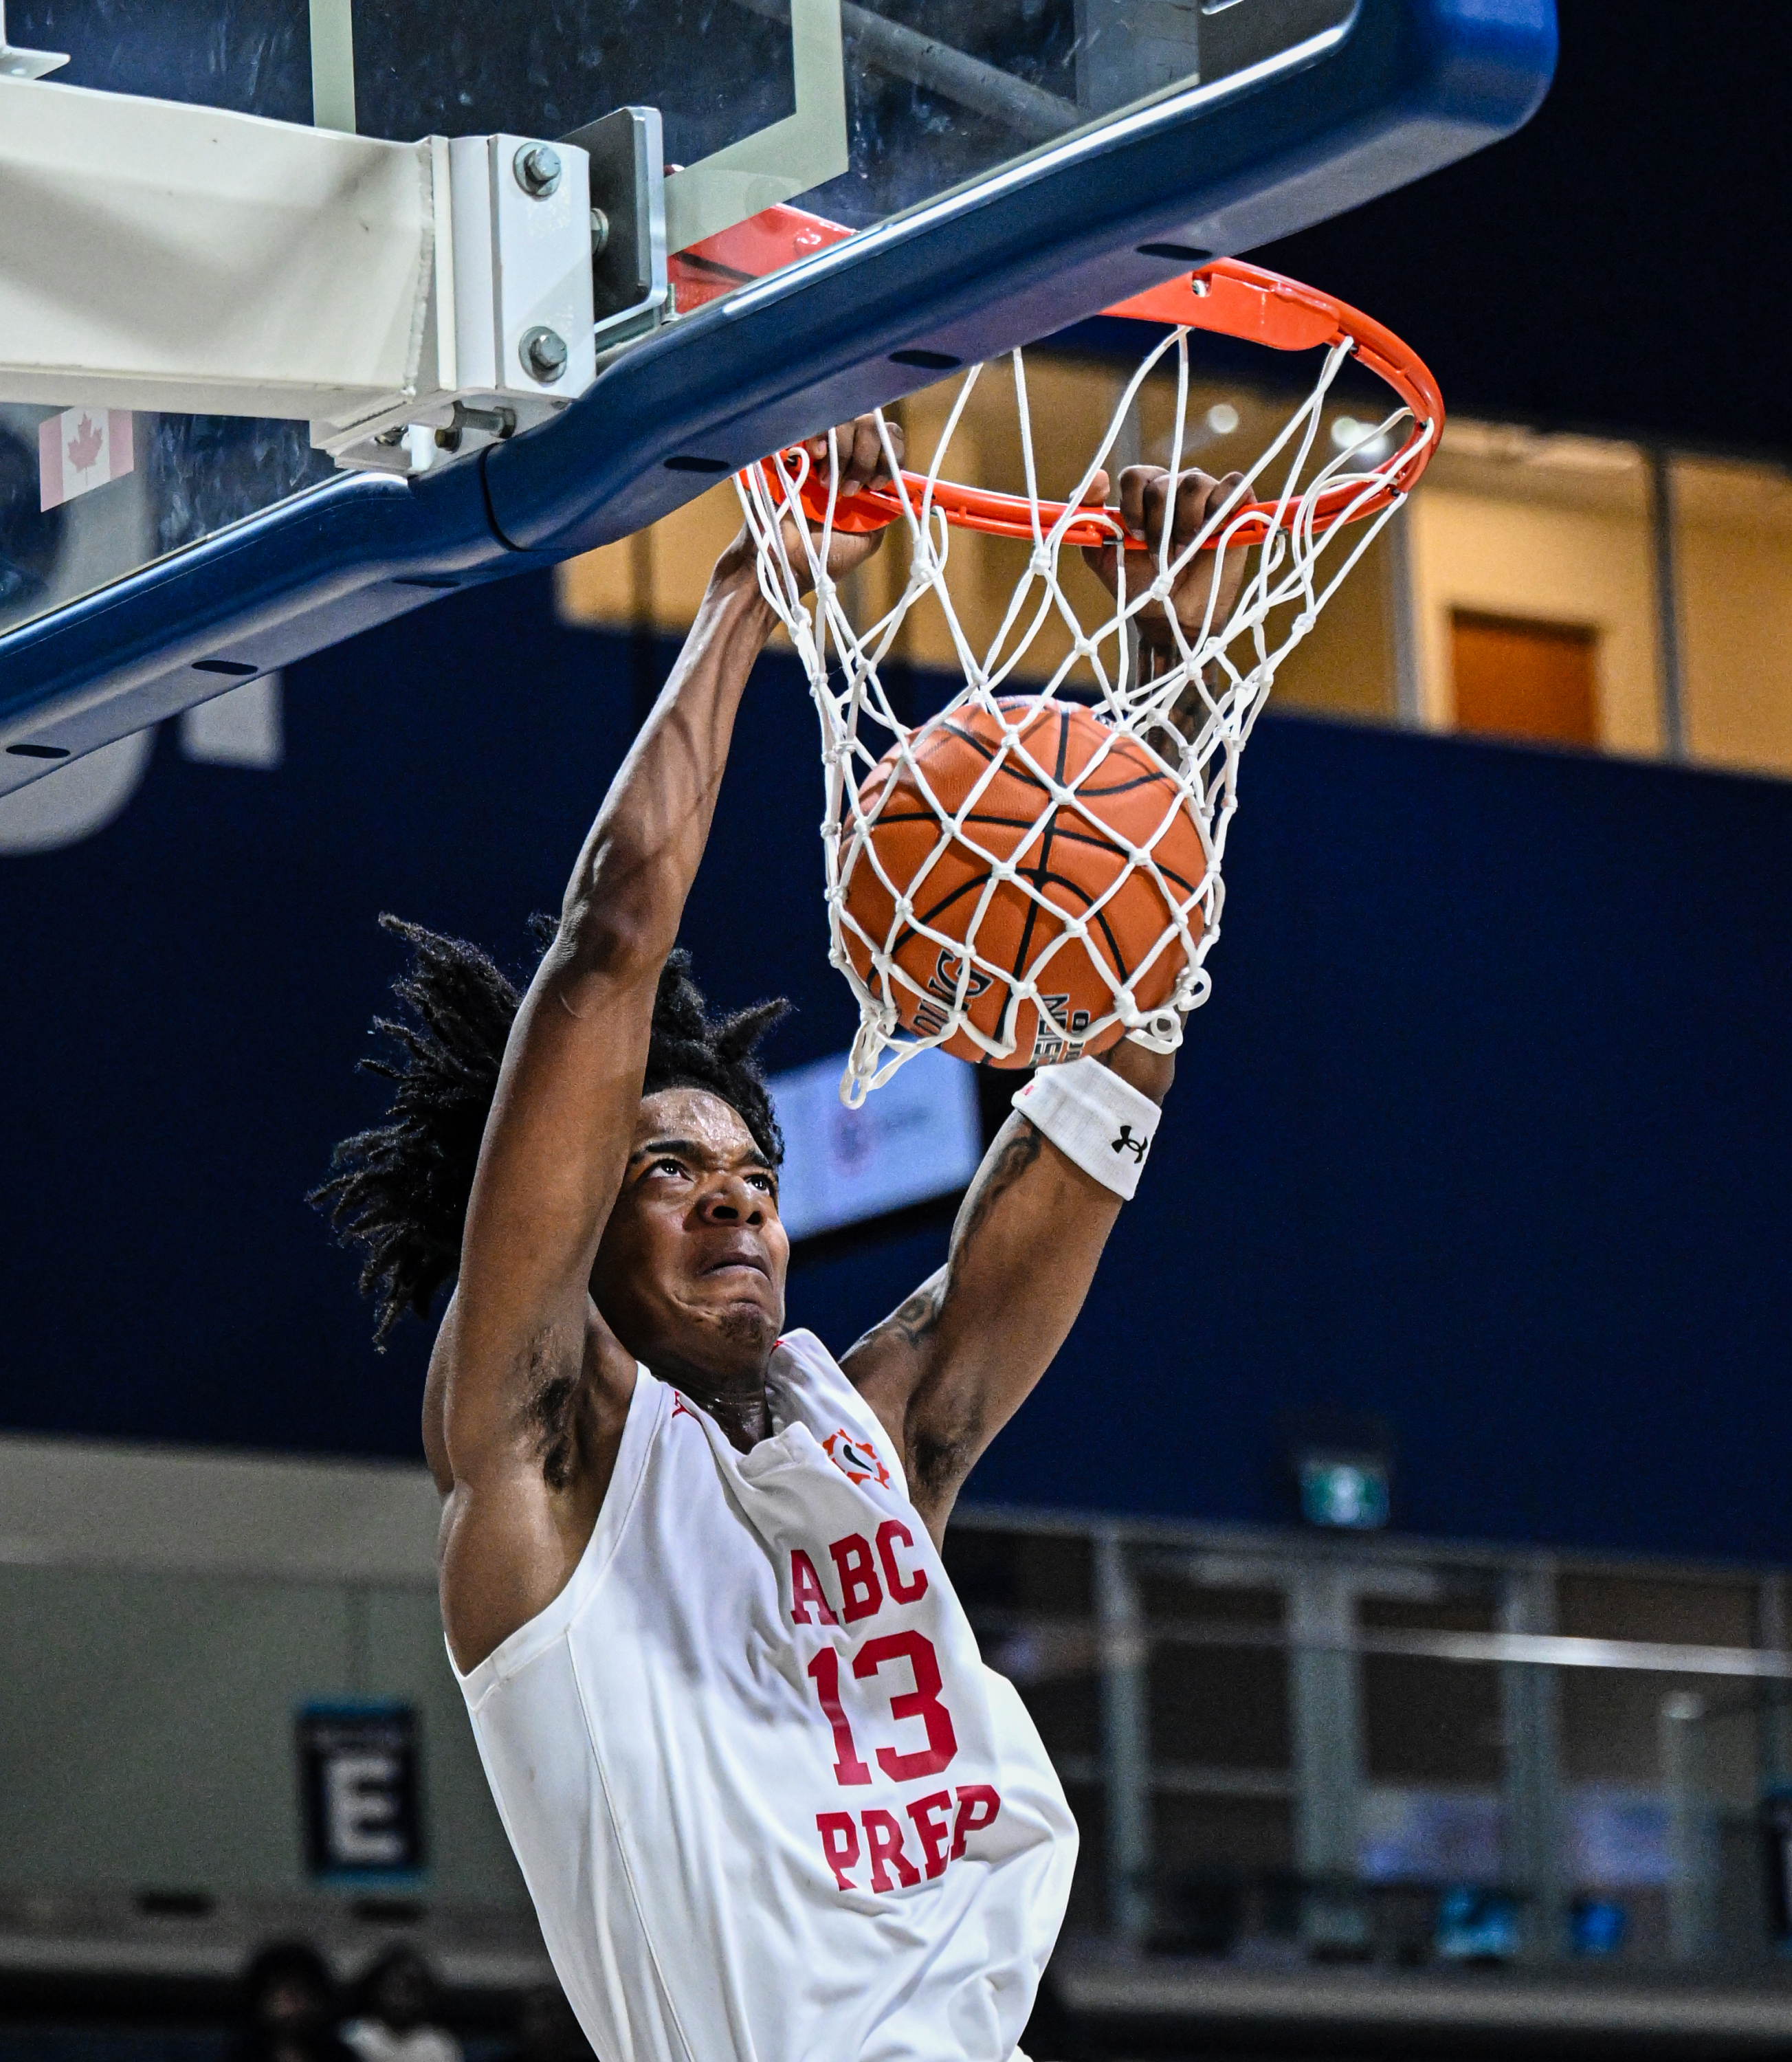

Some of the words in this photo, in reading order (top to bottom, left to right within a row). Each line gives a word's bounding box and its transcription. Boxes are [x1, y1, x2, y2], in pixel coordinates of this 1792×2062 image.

[790, 1520, 929, 1626] ABC
[807, 1629, 958, 1786] 13
[326, 1753, 404, 1861] E
[816, 1784, 1002, 1894] PREP
